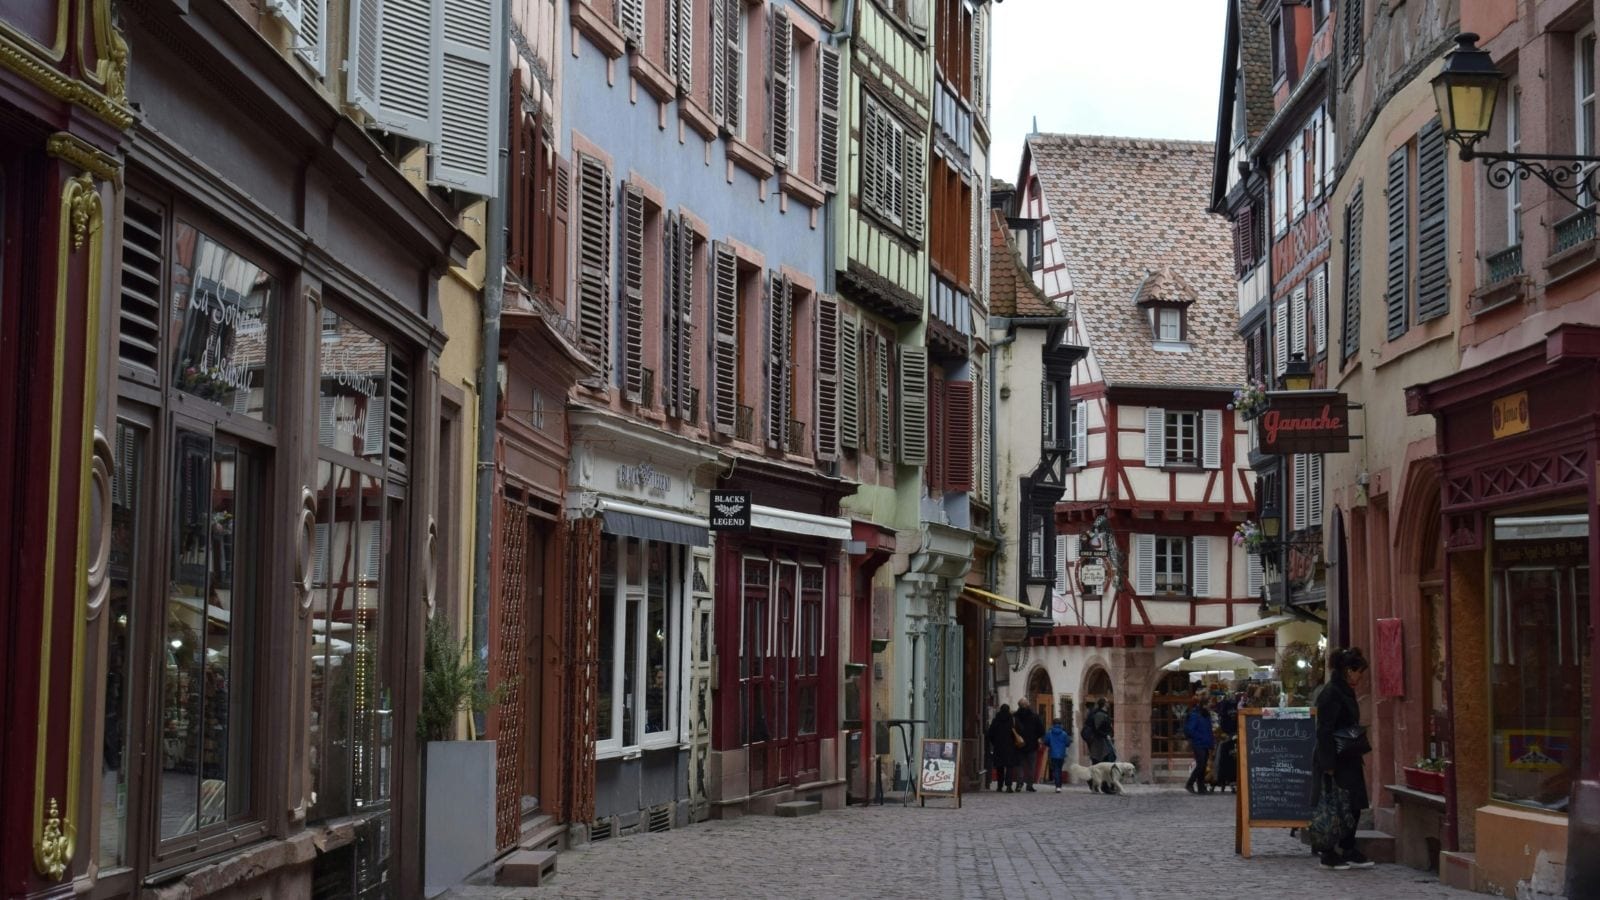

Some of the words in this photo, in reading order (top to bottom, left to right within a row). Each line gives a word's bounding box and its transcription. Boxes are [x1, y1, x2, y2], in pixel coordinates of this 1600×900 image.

[190, 267, 209, 315] La
[714, 495, 745, 503] BLACKS
[713, 518, 745, 526] LEGEND
